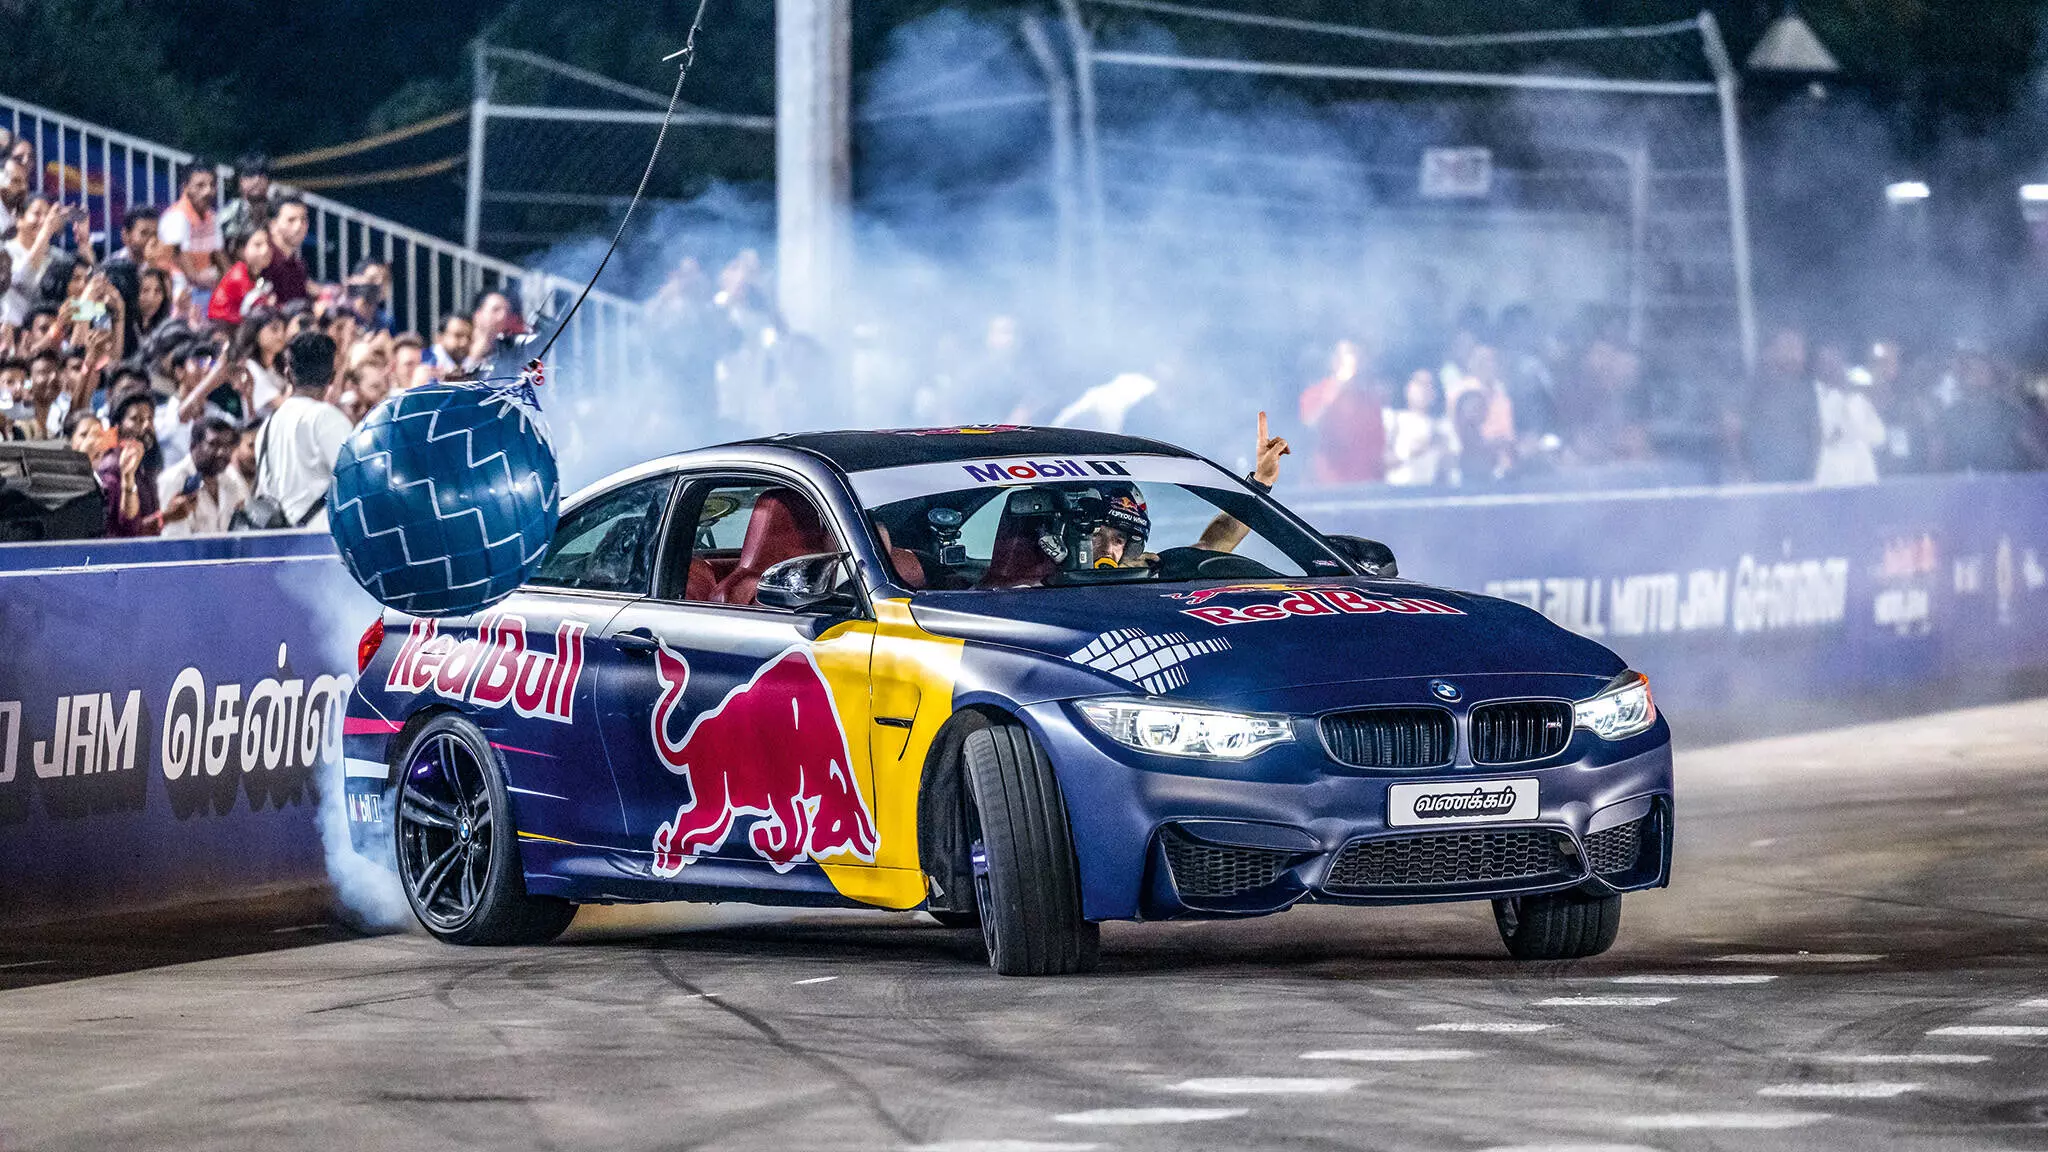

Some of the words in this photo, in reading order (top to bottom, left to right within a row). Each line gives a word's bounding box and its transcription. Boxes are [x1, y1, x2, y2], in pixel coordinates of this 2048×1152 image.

[962, 459, 1089, 482] Mobil
[1179, 590, 1341, 626] Red
[1312, 590, 1468, 616] Bull
[385, 612, 501, 702] Red
[469, 613, 590, 724] Bull
[34, 689, 141, 779] JAM
[1414, 786, 1516, 816] வணக்கம்
